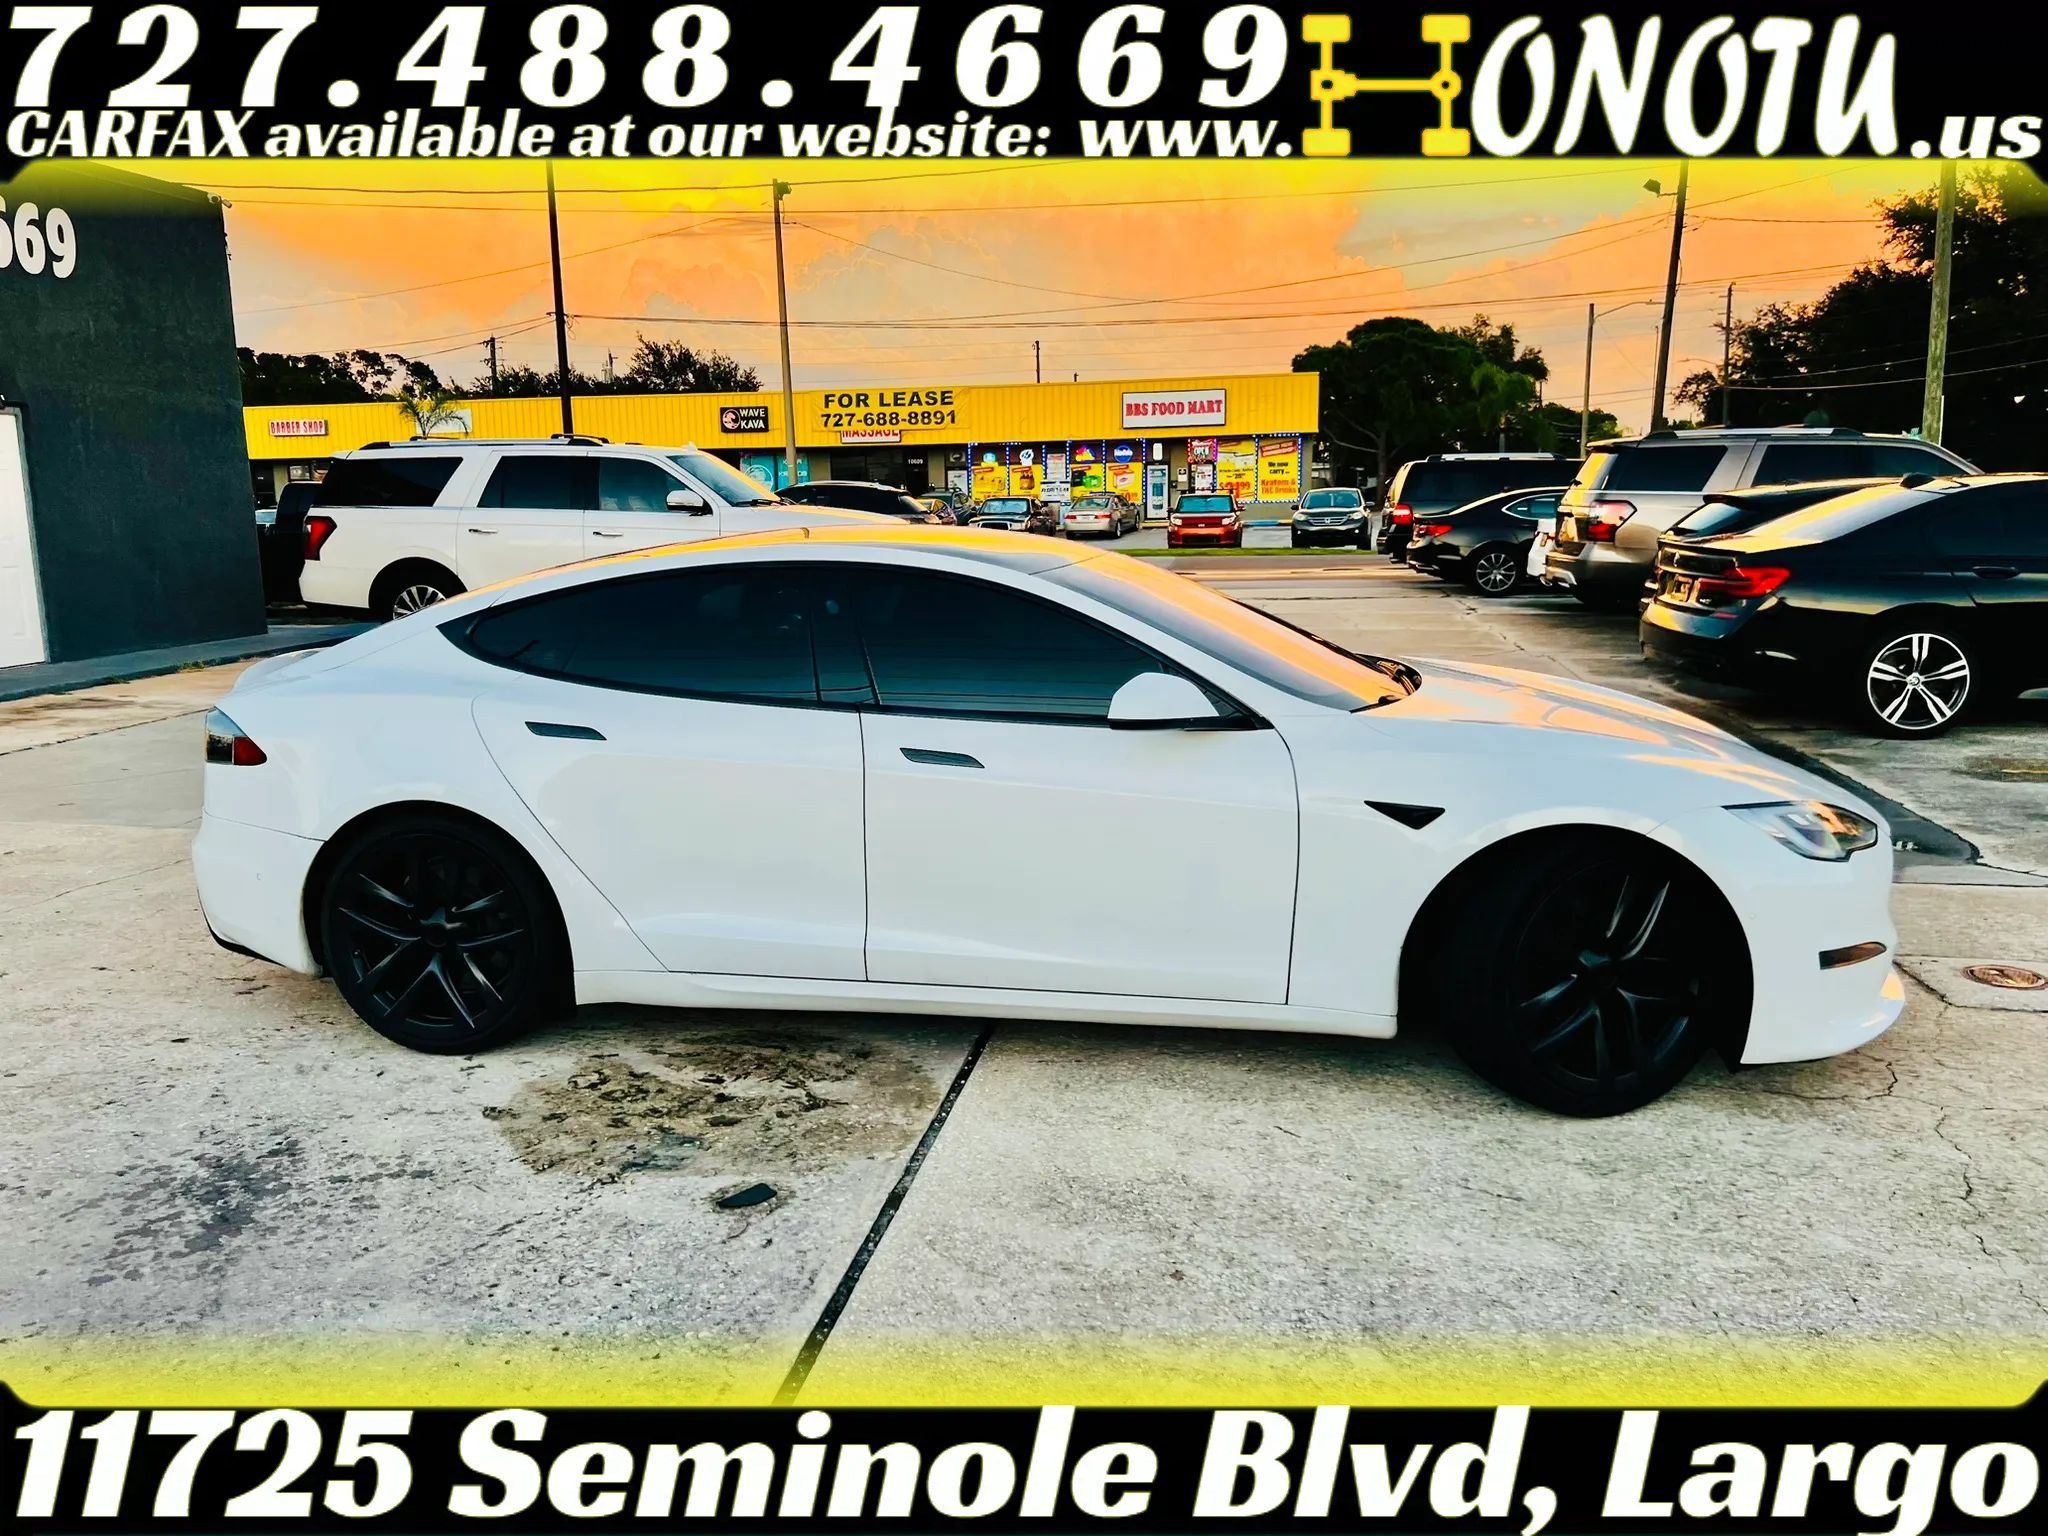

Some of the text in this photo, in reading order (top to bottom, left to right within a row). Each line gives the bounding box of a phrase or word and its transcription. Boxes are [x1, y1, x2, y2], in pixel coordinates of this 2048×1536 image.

[824, 388, 954, 408] FOR LEASE
[740, 408, 766, 417] WAVE
[1125, 400, 1223, 416] BBS FOOD MART
[740, 419, 766, 429] KAVA
[821, 409, 956, 428] 727-688-8891
[270, 420, 324, 434] BARBER SHOP
